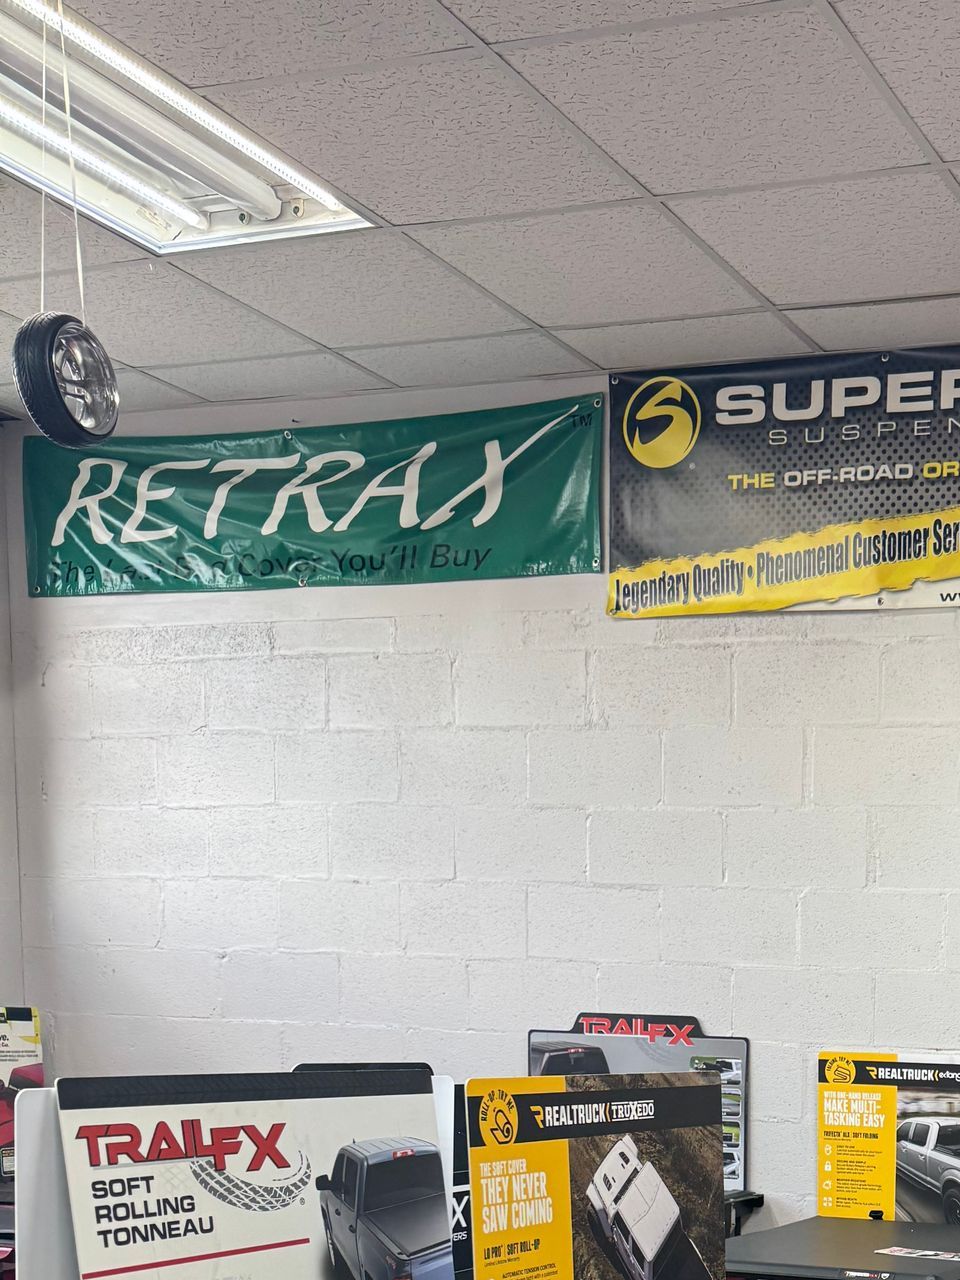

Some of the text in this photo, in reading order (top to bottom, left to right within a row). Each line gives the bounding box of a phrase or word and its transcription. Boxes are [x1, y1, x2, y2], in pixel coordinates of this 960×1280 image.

[51, 404, 579, 546] RETRAX
[728, 472, 775, 491] THE
[783, 463, 914, 486] OFF-ROAD
[331, 544, 417, 573] You'll
[429, 543, 492, 571] Buy
[614, 569, 691, 614] Legendary
[692, 558, 744, 602] Quality
[756, 536, 849, 587] Phenomenal
[852, 523, 929, 570] Customer
[579, 1017, 695, 1047] TRAILFX
[878, 1067, 934, 1081] REALTRUCK
[545, 1101, 654, 1127] REALTRUCK TRUXEDO
[824, 1099, 881, 1113] MAKE MULTI-
[824, 1111, 885, 1128] TASKING EASY
[75, 1119, 291, 1172] TRAILFX
[480, 1158, 527, 1176] THE SOFT COVER
[91, 1175, 155, 1200] SOFT
[480, 1171, 547, 1205] THEY NEVER
[94, 1195, 196, 1224] ROLLING
[482, 1196, 553, 1234] SAW COMING
[97, 1215, 215, 1248] TONNEAU
[484, 1247, 490, 1260] LO
[507, 1242, 519, 1256] SOFT
